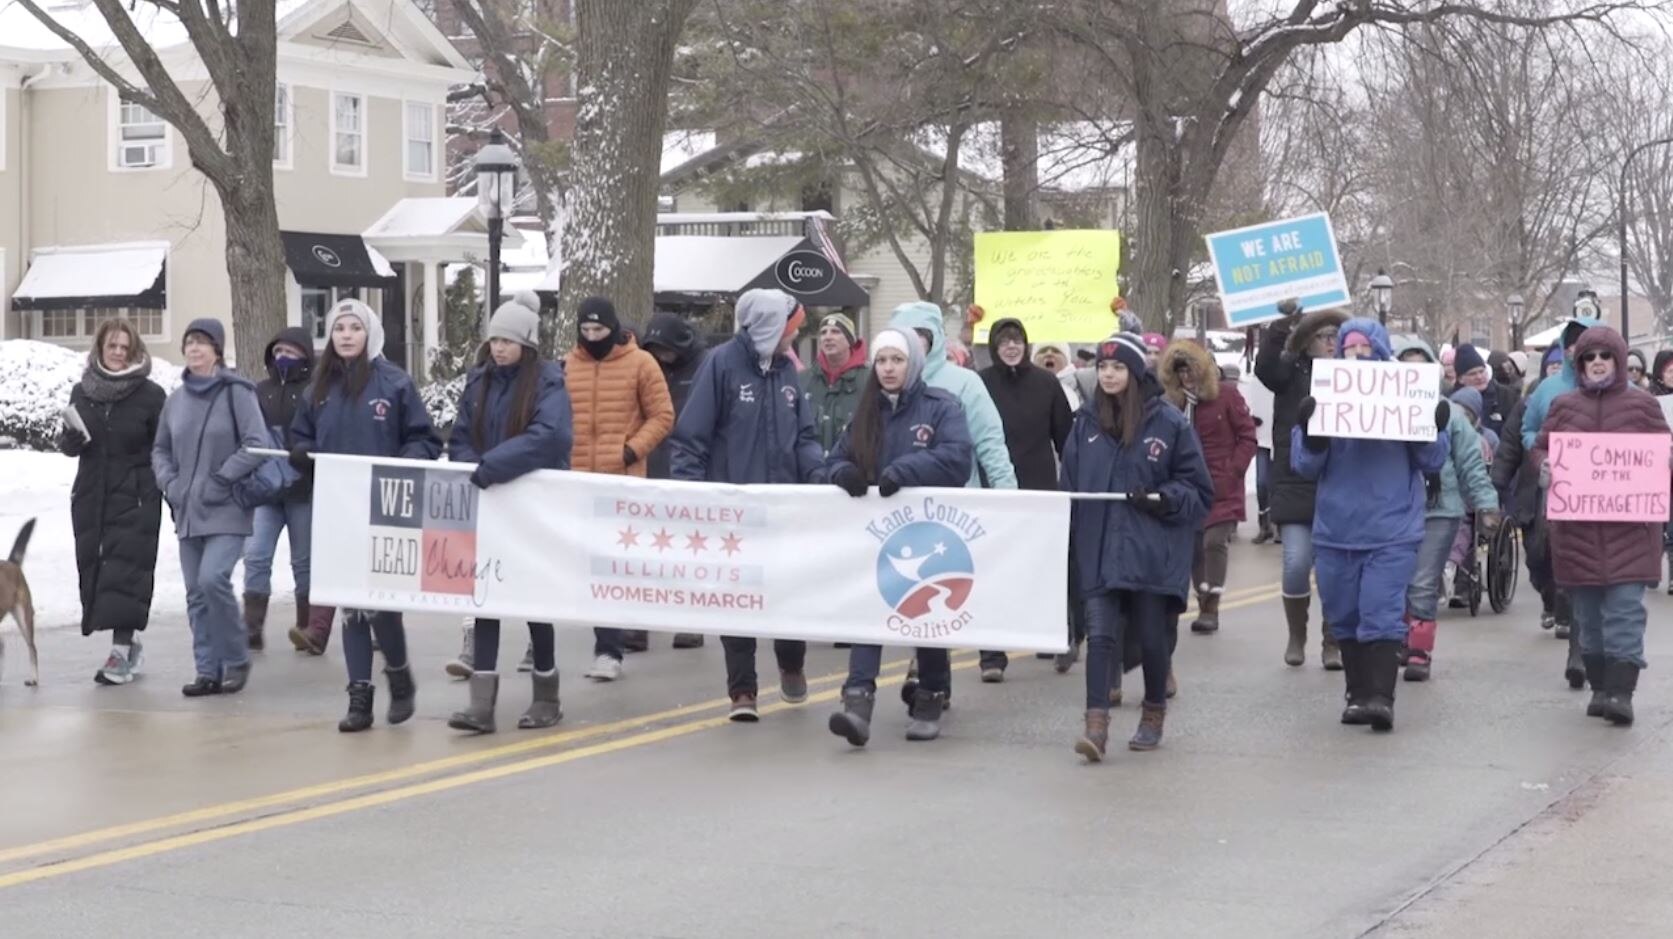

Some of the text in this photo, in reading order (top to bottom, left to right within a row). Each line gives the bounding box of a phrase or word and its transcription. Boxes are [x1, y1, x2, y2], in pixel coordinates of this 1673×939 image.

[1240, 230, 1303, 259] WE ARE
[1231, 250, 1325, 286] NOT AFRAID
[1591, 470, 1632, 481] OF THE
[379, 477, 473, 521] WE CAN
[615, 500, 745, 524] FOX VALLEY
[865, 496, 987, 544] Kane County
[370, 536, 504, 608] LEAD Change
[611, 560, 741, 583] ILLINOIS
[590, 583, 764, 611] WOMEN'S MARCH
[886, 609, 974, 639] Coalition
